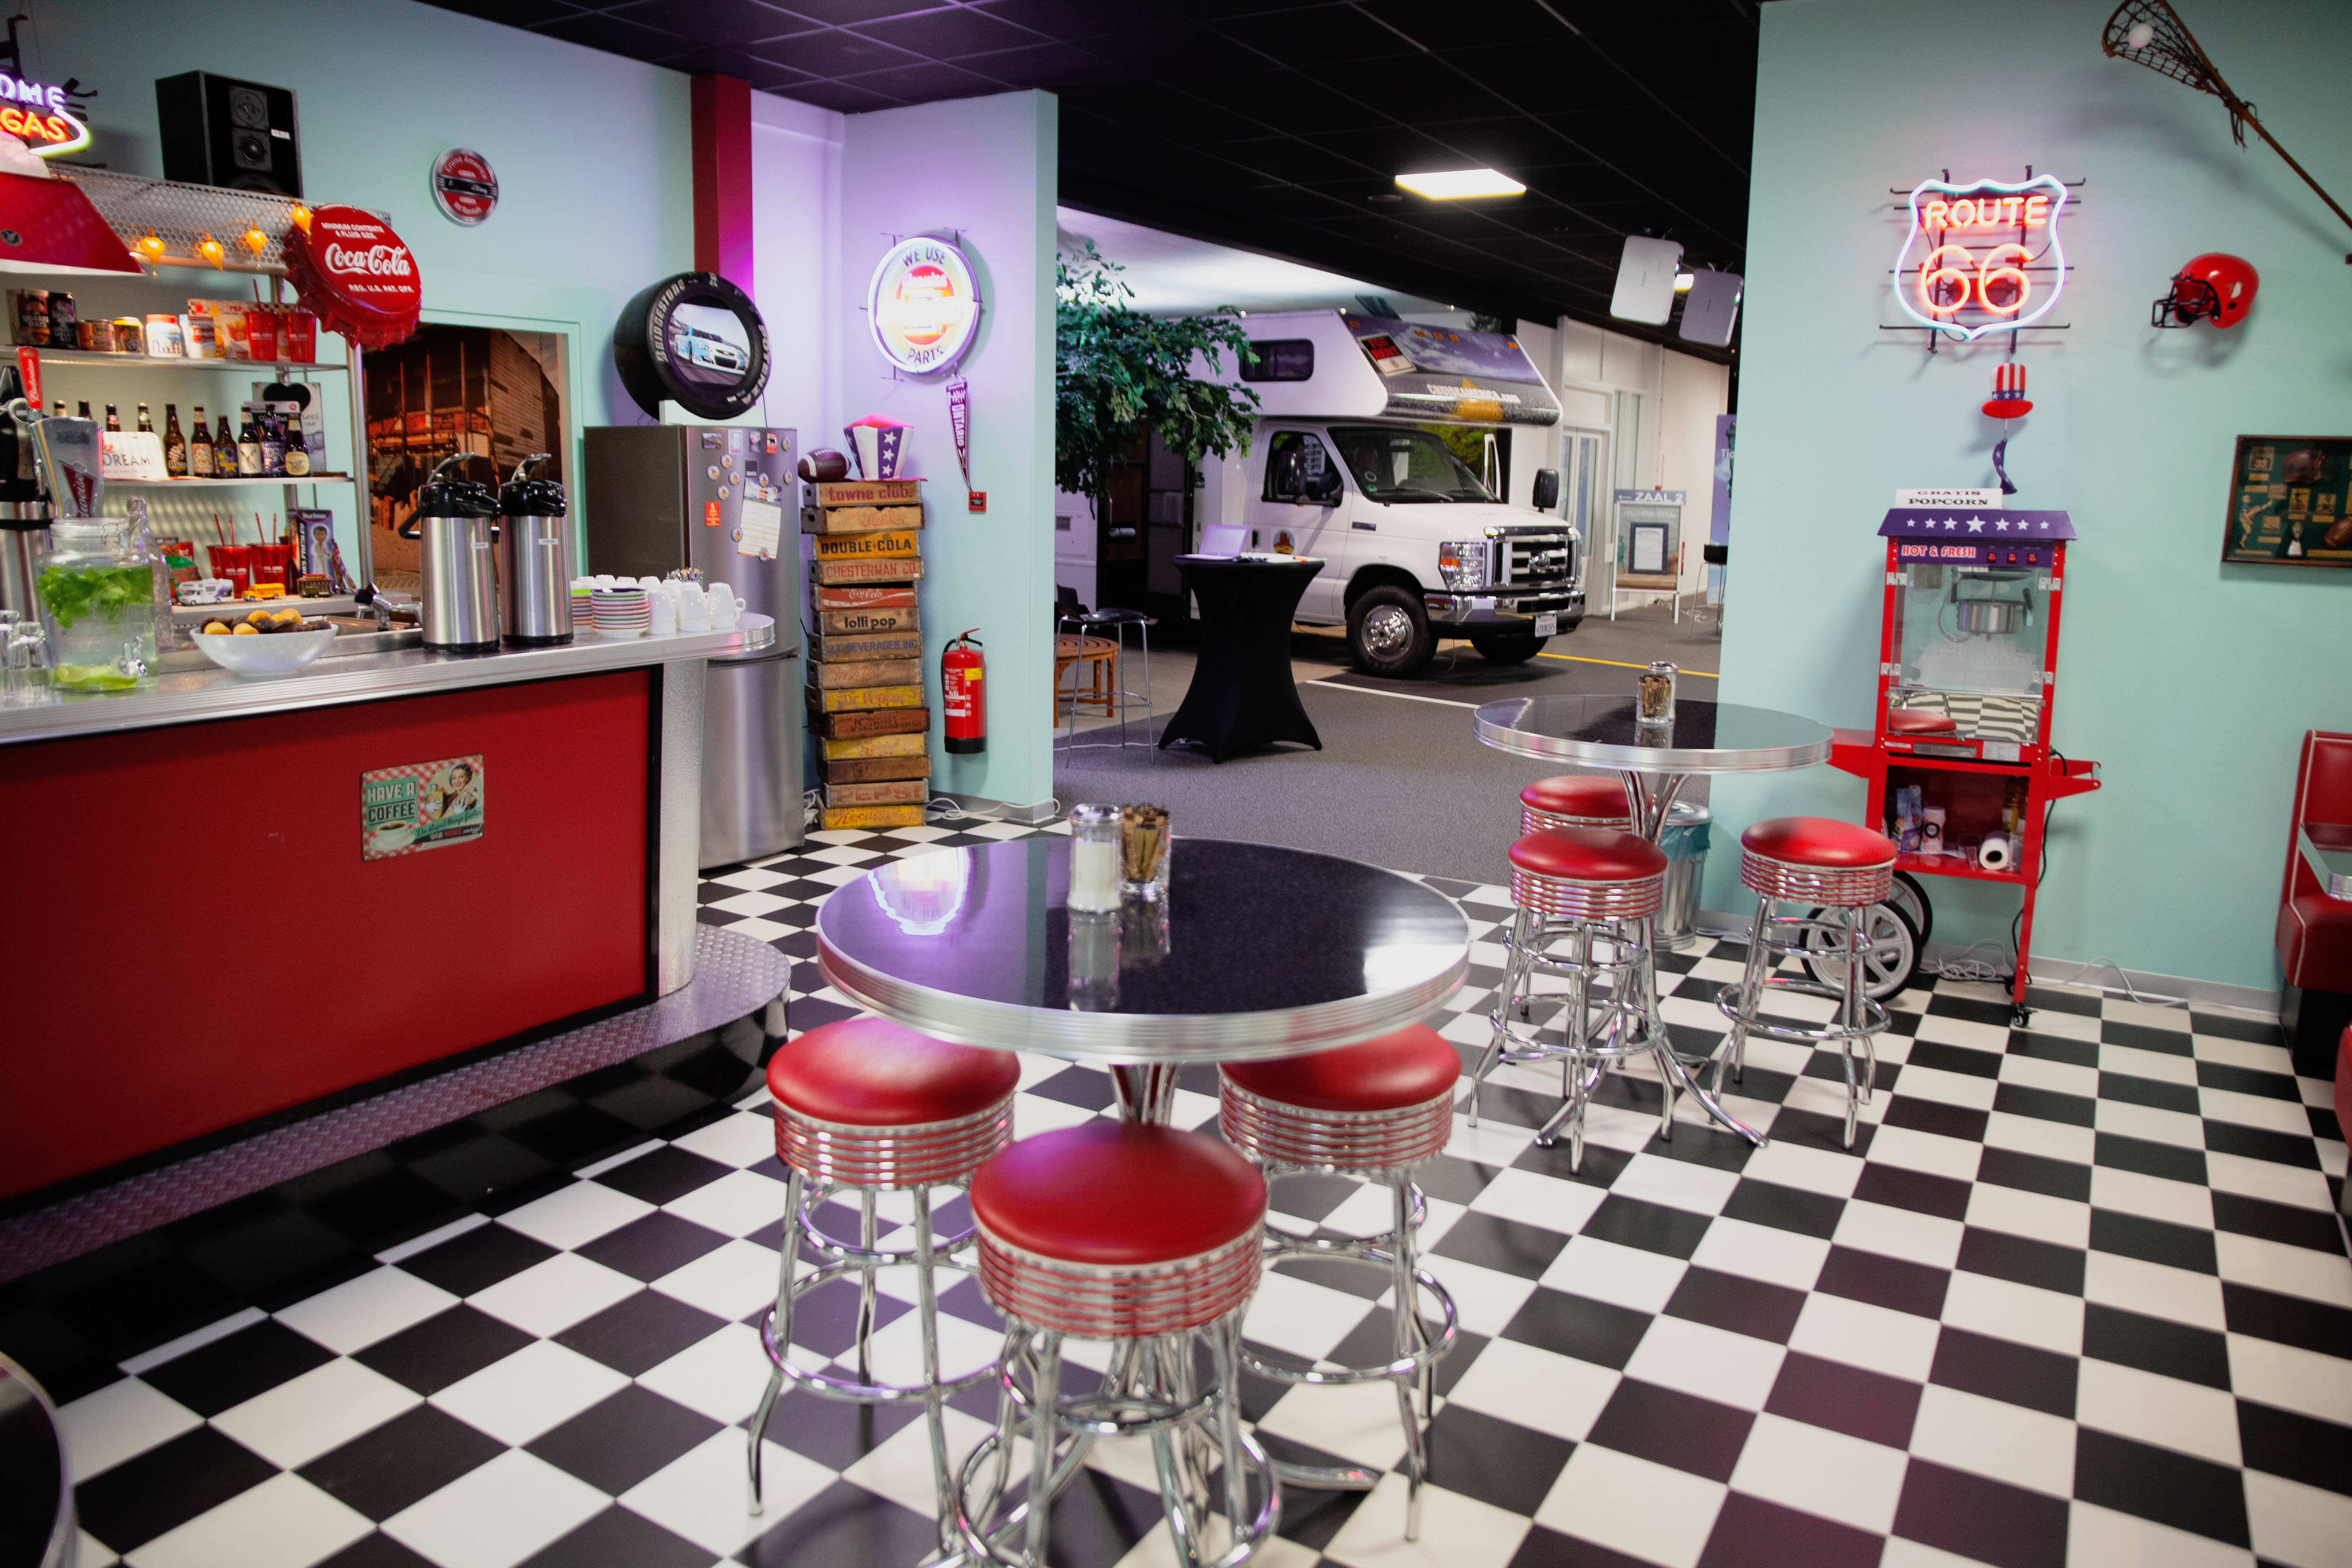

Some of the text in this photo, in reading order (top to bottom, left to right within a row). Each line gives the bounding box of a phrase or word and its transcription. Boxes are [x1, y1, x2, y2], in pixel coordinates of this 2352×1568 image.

[1925, 195, 2049, 230] ROUTE
[321, 222, 385, 233] MINIMUM CONTENTS
[325, 243, 411, 276] Coca-Cola
[903, 247, 945, 267] WE USE
[1921, 243, 2035, 313] 66
[652, 279, 686, 363] BRIDGESTONE
[1367, 337, 1388, 348] FOR
[907, 345, 943, 364] PARTS
[1370, 346, 1400, 360] RENT
[951, 404, 966, 447] ONTARIO
[828, 487, 874, 501] towne
[1635, 492, 1671, 503] ZAAL
[1675, 493, 1683, 503] 2
[1902, 545, 1926, 556] HOT
[1929, 546, 1939, 557] &
[1941, 546, 1976, 558] FRESH
[826, 562, 897, 578] CHESTERMAN
[368, 781, 416, 803] HAVE A
[369, 802, 416, 822] COFFEE
[416, 809, 481, 836] Do stupid things faster
